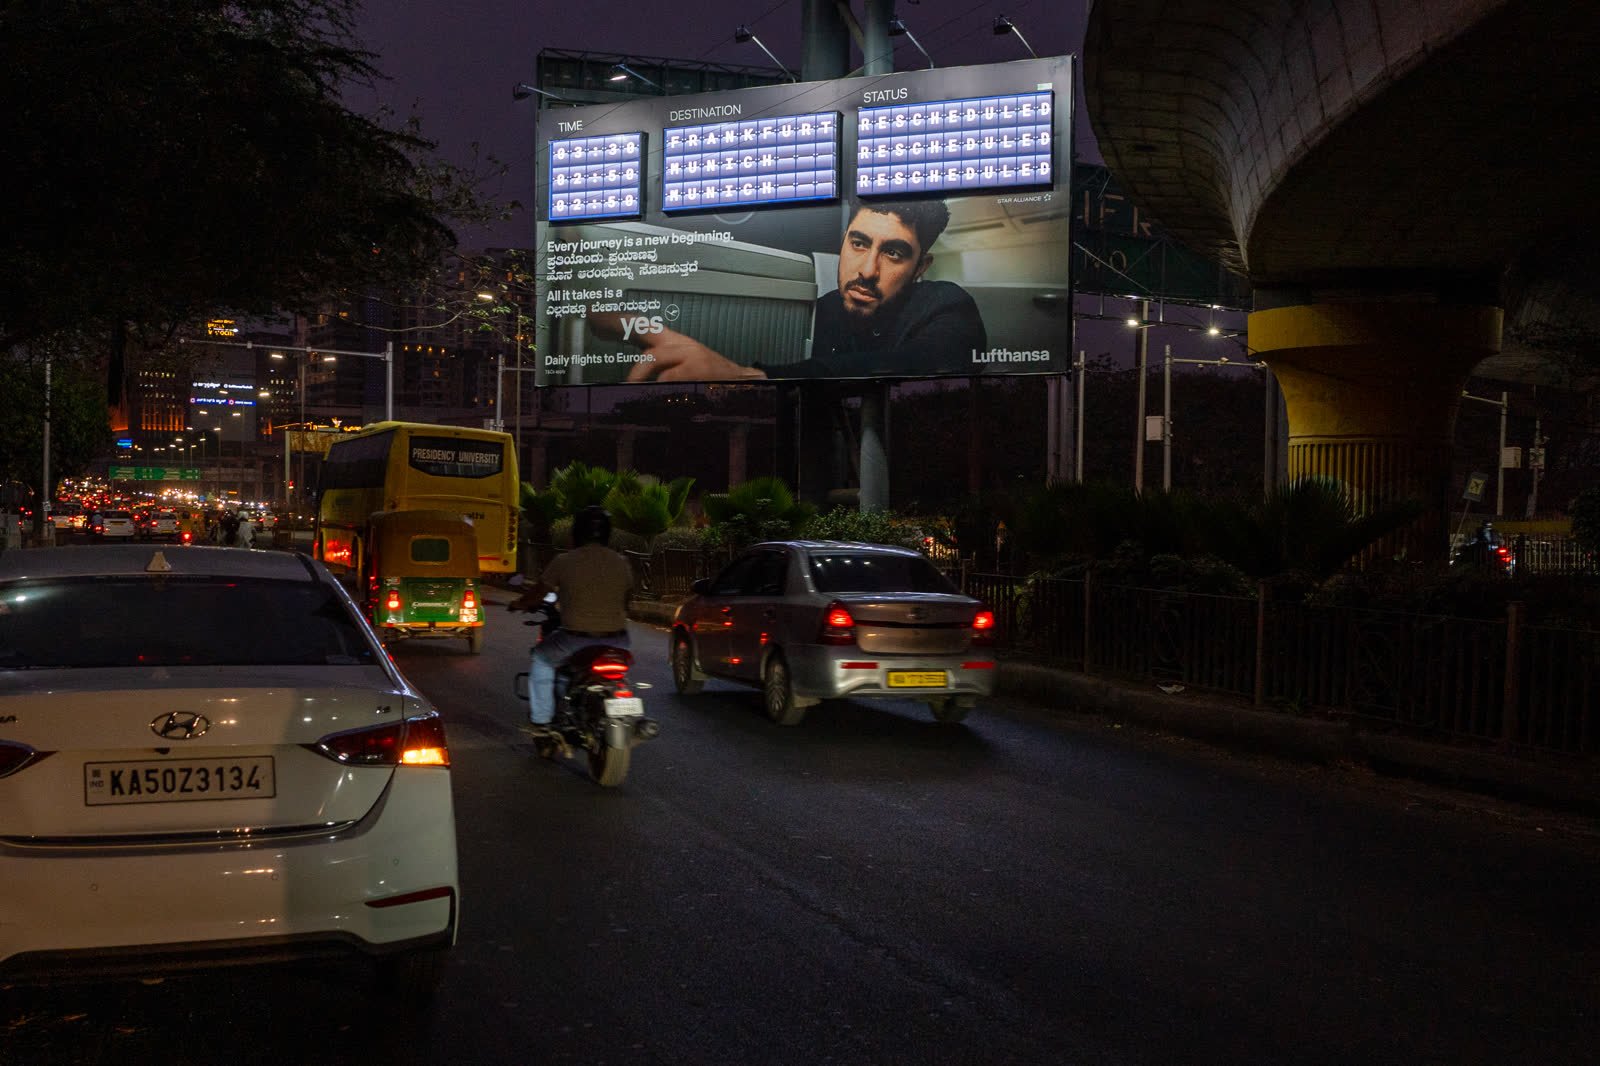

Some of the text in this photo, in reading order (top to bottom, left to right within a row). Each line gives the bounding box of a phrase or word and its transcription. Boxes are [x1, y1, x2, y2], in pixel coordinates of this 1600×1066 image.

[863, 88, 908, 104] STATUS
[670, 104, 742, 122] DESTINATION
[861, 102, 1050, 131] RESCHEDULED
[558, 120, 583, 132] TIME
[671, 121, 831, 148] FRANKFURT
[556, 142, 635, 160] 03:30
[860, 132, 1050, 159] RESCHEDULED
[670, 154, 772, 175] MUNICH
[556, 168, 634, 186] 02:50
[860, 162, 1050, 188] RESCHEDULED
[669, 182, 772, 201] MUNICH
[1013, 195, 1042, 203] ALLIANCE
[556, 194, 634, 212] 02:50
[547, 230, 734, 253] Every journey is a new beginning.
[547, 288, 623, 301] All it takes is a
[620, 315, 664, 340] yes
[545, 352, 656, 367] Daily flights to Europe.
[972, 348, 1050, 363] Lufthansa
[412, 448, 500, 464] PRESIDENCY UNIVERSITY
[110, 765, 260, 796] KA50Z3134
